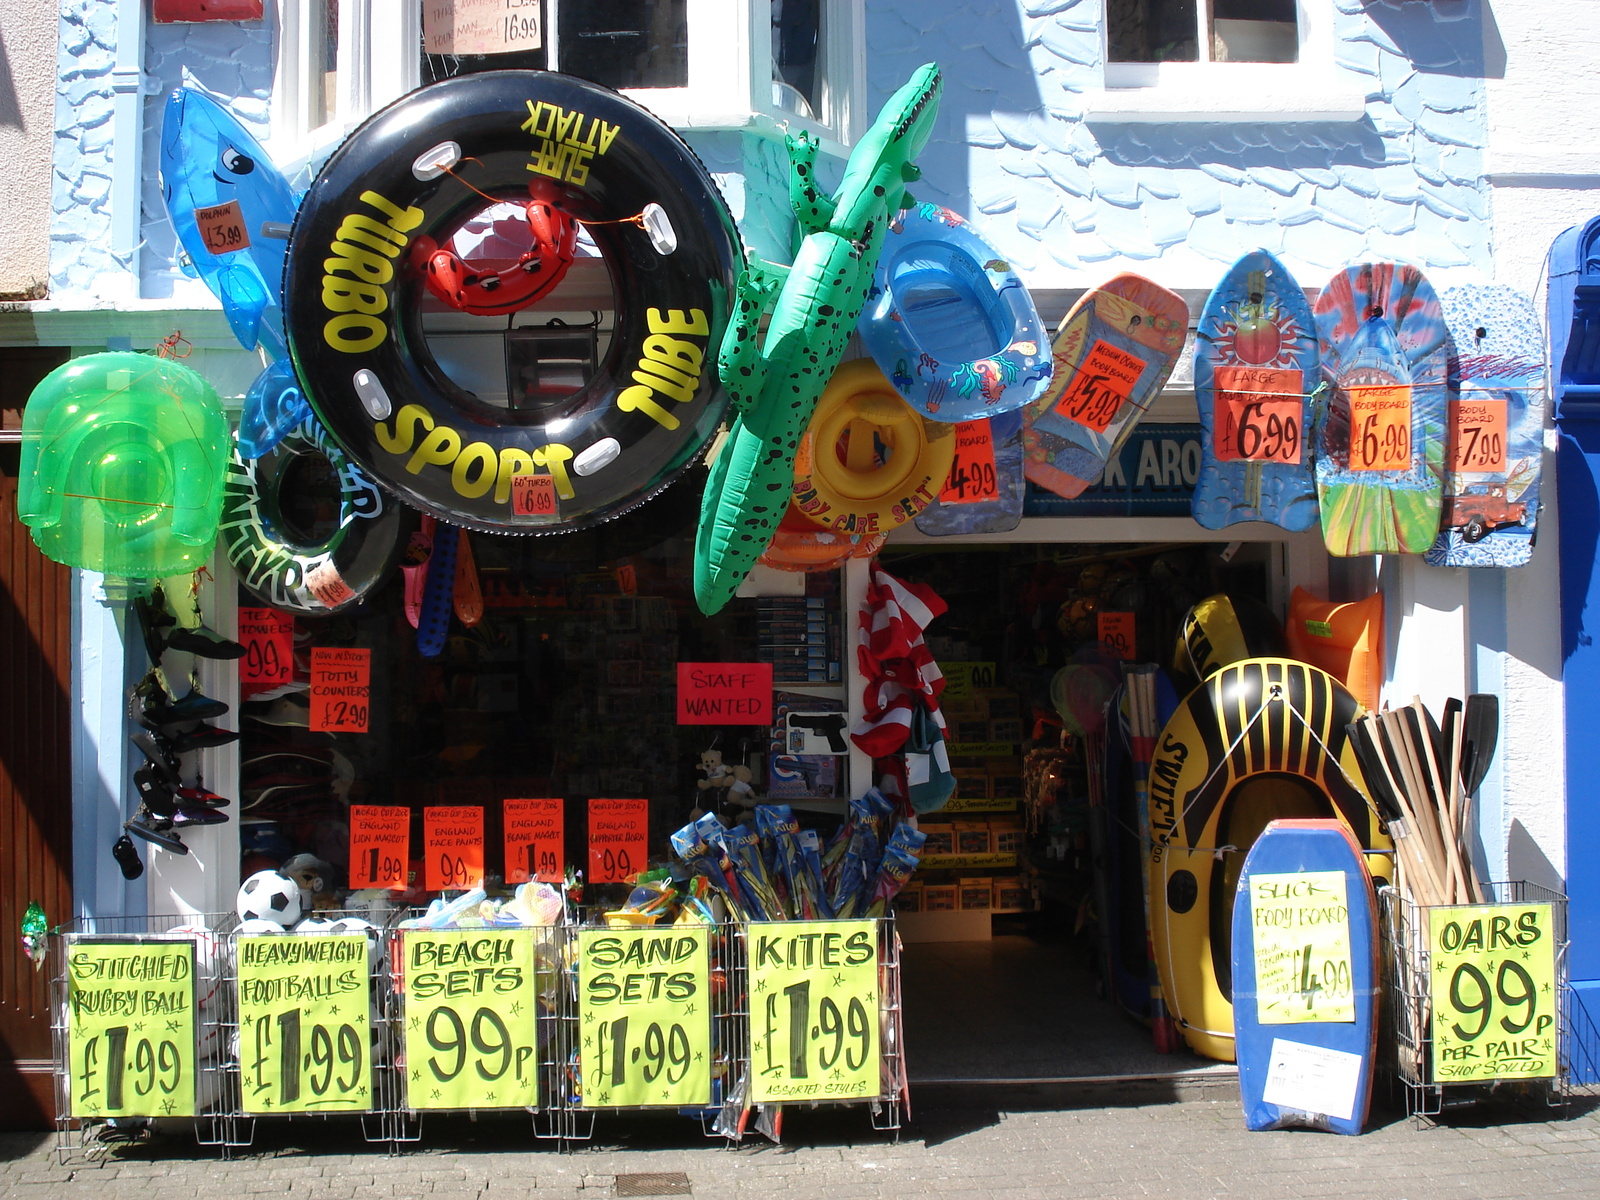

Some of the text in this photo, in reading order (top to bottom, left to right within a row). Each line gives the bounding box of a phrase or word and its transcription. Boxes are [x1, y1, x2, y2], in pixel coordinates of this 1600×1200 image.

[457, 19, 479, 37] MAN
[493, 13, 537, 44] £16.99
[520, 99, 621, 155] ATTACK
[526, 139, 594, 187] SURF
[200, 206, 231, 220] DOLPHIN
[207, 225, 242, 249] £3.99
[321, 189, 425, 353] TURBO
[1096, 344, 1121, 362] MEDIUM
[616, 307, 710, 431] TUBE
[1090, 358, 1135, 383] BODY BOARD
[1234, 371, 1288, 384] LARGE
[1061, 374, 1121, 427] £5.99
[1358, 388, 1396, 397] LARGE
[1355, 400, 1410, 411] BODY BOARD
[1459, 406, 1487, 415] BODY
[1221, 402, 1299, 460] £6.99
[1457, 415, 1495, 425] BOARD
[960, 435, 988, 447] BOARD
[1353, 413, 1408, 467] £6.99
[1454, 427, 1502, 467] £7.99
[374, 403, 576, 505] SPORT
[527, 479, 551, 488] TURBO
[517, 489, 552, 512] £6.99
[316, 581, 345, 603] £1.99
[243, 610, 279, 621] TEA
[240, 622, 293, 634] TOWELS
[316, 670, 359, 683] TOTTY
[691, 669, 756, 688] STAFF
[313, 685, 370, 698] COUNTERS
[321, 702, 367, 729] £2.99
[685, 698, 762, 716] WANTED
[1152, 732, 1189, 838] SWIFT
[360, 822, 400, 831] ENGLAND
[435, 827, 476, 836] ENGLAND
[511, 820, 554, 828] ENGLAND
[596, 821, 637, 830] ENGLAND
[774, 821, 797, 833] Kite
[861, 815, 877, 825] Kite
[353, 834, 406, 844] LION MASCOT
[430, 837, 482, 847] FACE PAINTS
[514, 843, 557, 879] £1.99
[682, 844, 704, 860] Kite
[357, 848, 402, 883] £1.99
[882, 858, 905, 879] Kite
[1259, 881, 1333, 899] SLICK
[1255, 905, 1347, 929] BODY BOARD
[1439, 912, 1542, 954] OARS
[242, 940, 366, 967] HEAVYWEIGHT
[411, 938, 515, 970] BEACH
[586, 936, 699, 969] SAND
[756, 931, 875, 970] KITES
[72, 953, 190, 983] STITCHED
[1288, 944, 1351, 1010] £4.99
[241, 969, 362, 1005] FOOTBALLS
[411, 967, 524, 1001] SETS
[586, 972, 697, 1006] SETS
[74, 988, 189, 1017] RUGBY BALL
[760, 979, 871, 1079] £1.99
[251, 1007, 363, 1106] £1.99
[590, 1015, 691, 1089] £1.99
[1442, 1038, 1547, 1061] PER PAIR
[79, 1025, 182, 1110] £1.99
[1439, 1060, 1544, 1076] SHOP SOILED
[766, 1080, 868, 1095] ASSORTED STYLES
